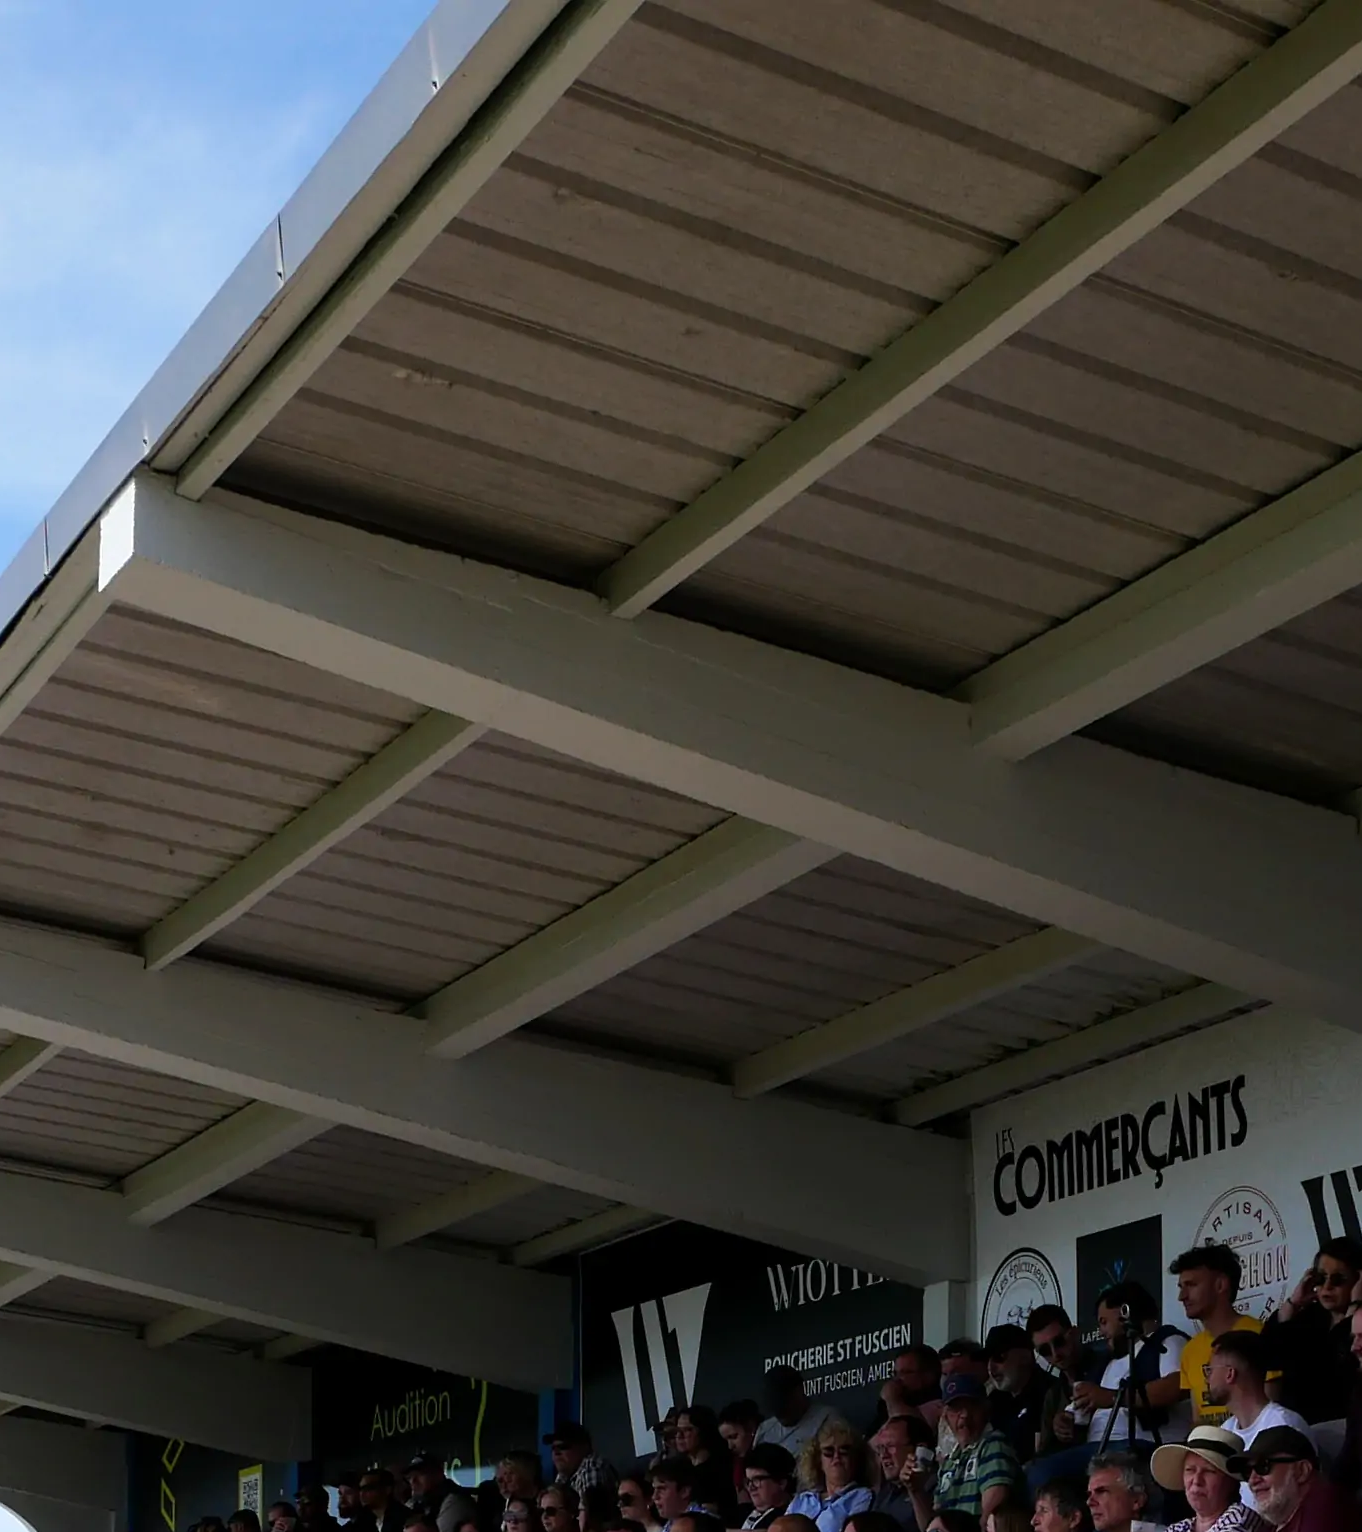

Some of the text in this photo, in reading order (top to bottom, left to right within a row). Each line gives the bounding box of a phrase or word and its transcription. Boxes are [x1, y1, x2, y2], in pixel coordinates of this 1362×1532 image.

[994, 1075, 1248, 1216] COMMERÇANTS
[995, 1127, 1015, 1158] LES
[1222, 1232, 1253, 1245] DEPUIS
[995, 1274, 1009, 1296] Les
[1008, 1260, 1048, 1290] épicuriens
[836, 1338, 854, 1362] ST
[855, 1322, 912, 1357] FUSCIEN
[824, 1366, 866, 1393] FUSCIEN,
[369, 1387, 453, 1442] Audition
